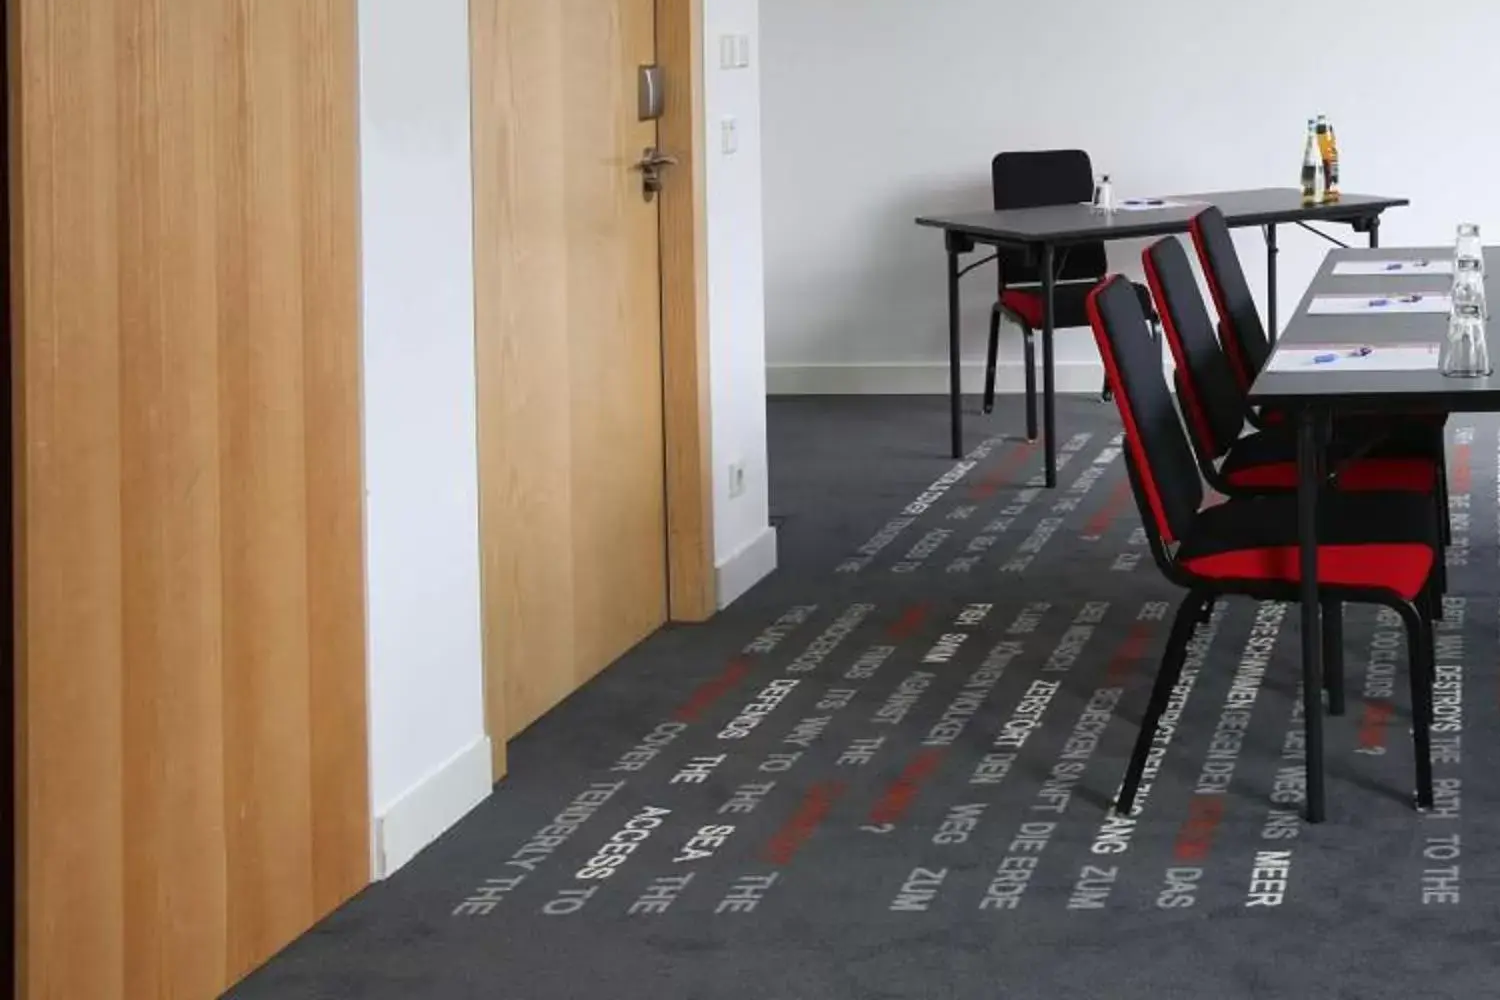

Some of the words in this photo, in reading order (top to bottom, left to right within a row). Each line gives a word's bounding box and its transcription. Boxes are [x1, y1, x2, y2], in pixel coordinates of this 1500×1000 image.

[842, 645, 896, 678] FINDS
[714, 679, 800, 738] DEFENDS
[813, 689, 858, 709] ITS
[869, 671, 937, 723] AGAINST
[990, 679, 1066, 746] ZERSTÖRT
[1431, 665, 1460, 730] DESTROYS
[610, 723, 688, 770] COVER
[780, 715, 834, 745] WAY
[1351, 745, 1384, 754] ?
[669, 754, 727, 782] THE
[754, 751, 803, 771] TO
[834, 737, 885, 764] THE
[968, 753, 1017, 782] DEN
[1430, 737, 1458, 763] THE
[1031, 762, 1087, 812] SANFT
[1196, 762, 1234, 792] DEN
[717, 782, 776, 812] THE
[1428, 779, 1458, 817] PATH
[499, 781, 625, 868] TENDERLY
[573, 806, 675, 879] ACCESS
[671, 824, 738, 861] SEA
[859, 823, 892, 832] ?
[929, 803, 987, 843] WEG
[1010, 822, 1056, 852] DIE
[1425, 834, 1459, 858] TO
[447, 874, 525, 915] THE
[624, 872, 697, 913] THE
[713, 872, 779, 912] THE
[888, 867, 948, 911] ZUM
[980, 856, 1040, 908] ERDE
[1067, 866, 1118, 909] ZUM
[1156, 867, 1202, 908] DAS
[1244, 851, 1288, 906] MEER
[1422, 865, 1459, 904] THE
[538, 886, 598, 913] TO
